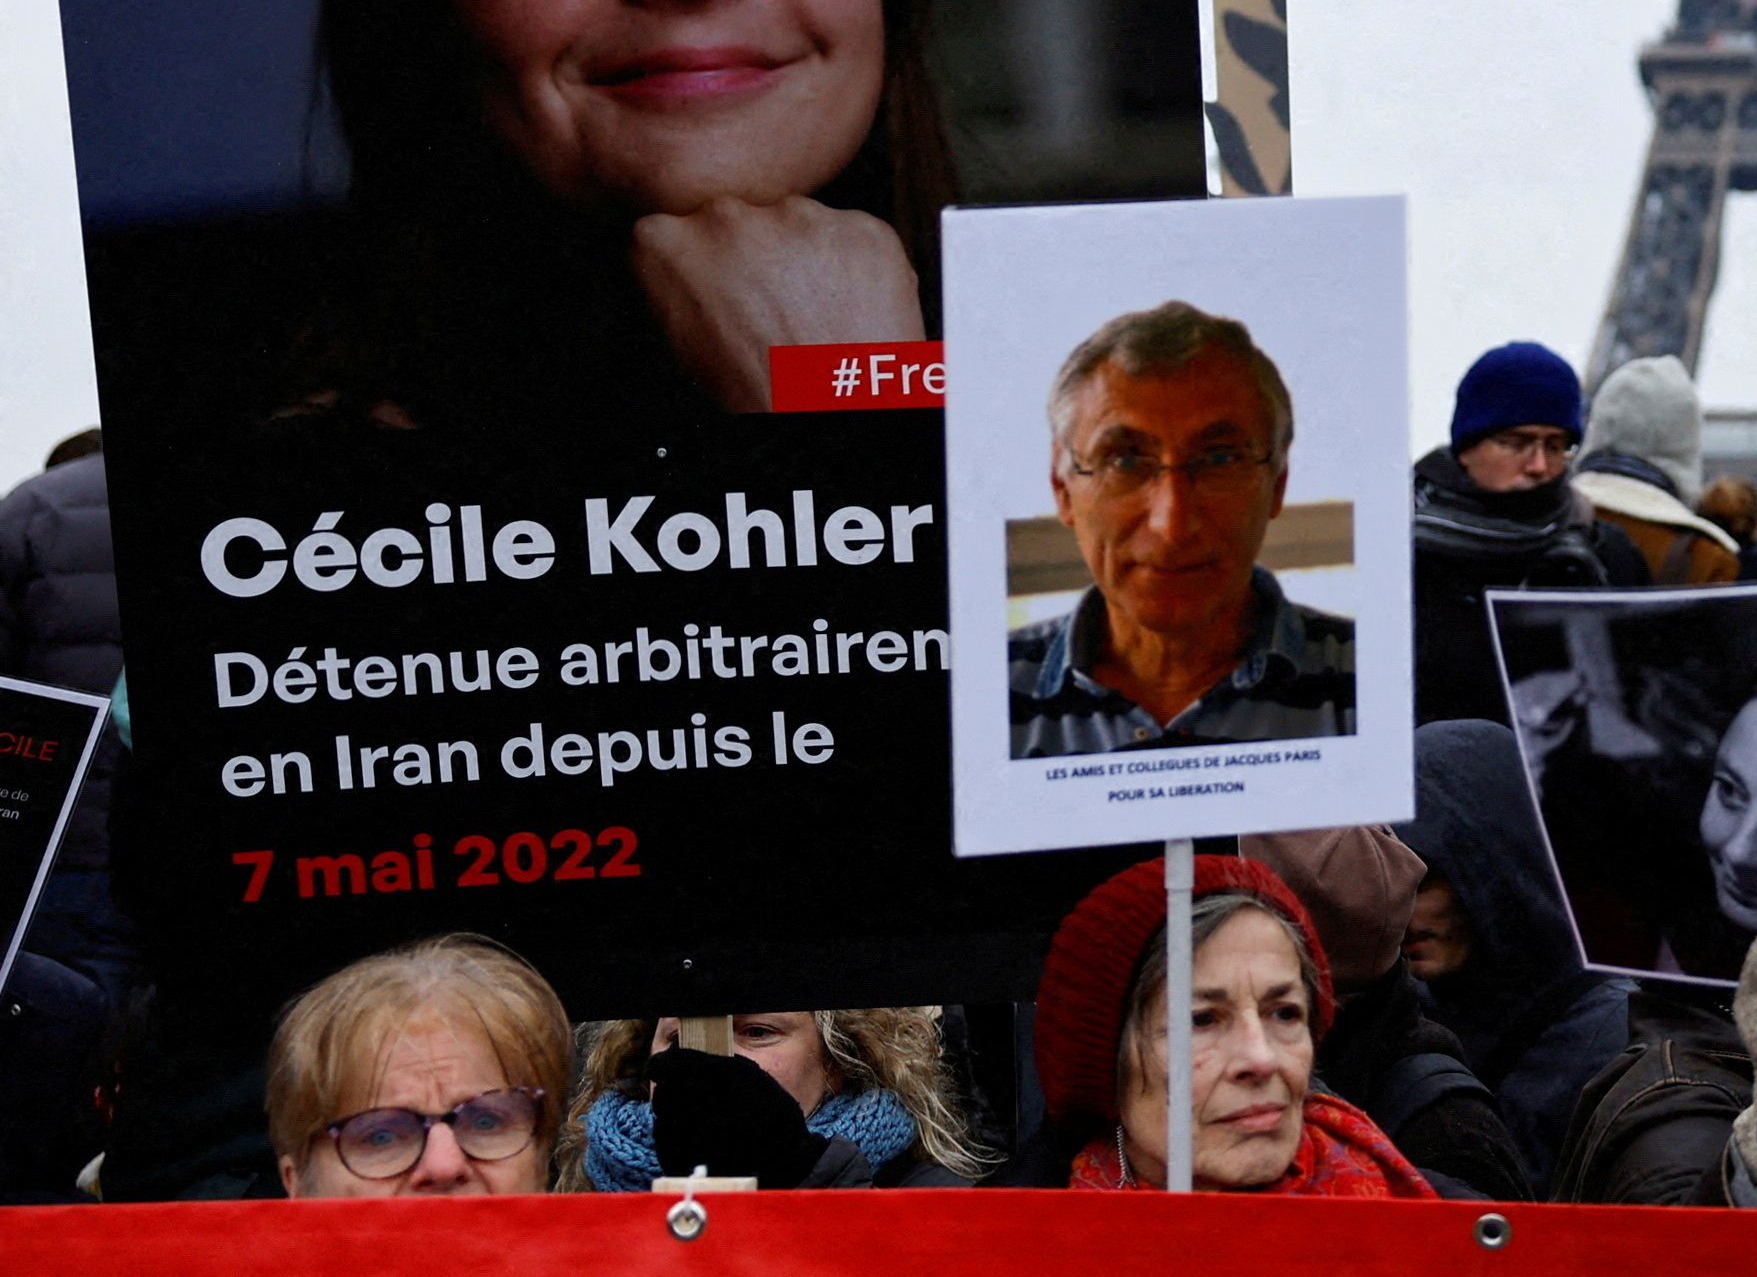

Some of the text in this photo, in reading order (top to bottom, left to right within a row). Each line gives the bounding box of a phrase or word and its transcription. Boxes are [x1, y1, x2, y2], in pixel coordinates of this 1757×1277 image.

[831, 354, 945, 397] #Fre
[200, 489, 934, 598] Cécile Kohler
[214, 646, 540, 708] Détenue
[221, 711, 835, 797] en Iran depuis le
[1046, 749, 1322, 781] LES AMIS ET COLLEGUES DE JACQUES PARIS
[11, 789, 29, 802] de
[1108, 782, 1244, 802] POUR SA LIBERATION
[232, 826, 641, 903] 7 mai 2022
